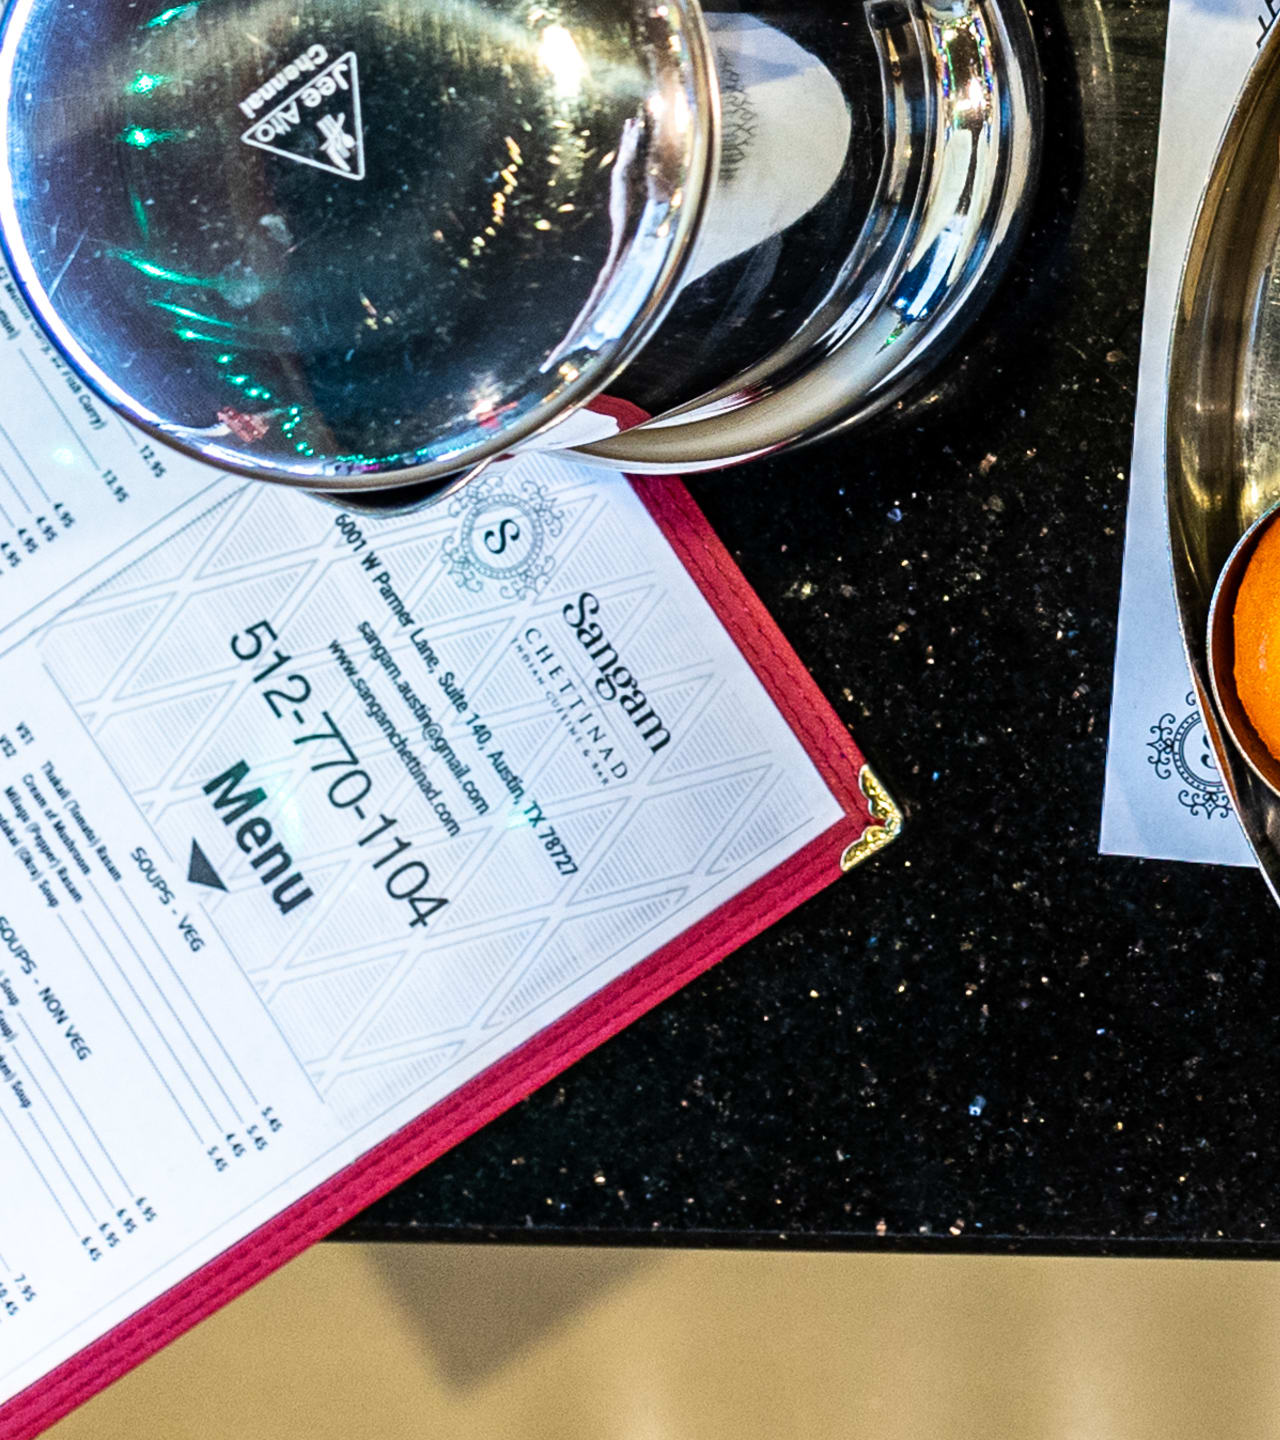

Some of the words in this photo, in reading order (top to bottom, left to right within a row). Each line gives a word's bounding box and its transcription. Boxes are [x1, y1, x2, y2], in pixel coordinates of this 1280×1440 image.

[301, 63, 349, 108] Jee
[140, 445, 166, 477] 12.95
[37, 517, 57, 542] 4.95
[54, 503, 74, 528] 4.95
[18, 529, 38, 553] 4.95
[563, 592, 671, 754] Sangam
[335, 512, 367, 552] 6001
[361, 551, 381, 571] W
[372, 571, 415, 627] Parmer
[410, 628, 439, 673] Lane,
[438, 672, 468, 713] Suite
[466, 713, 492, 750] 140,
[487, 751, 524, 804] Austin,
[524, 800, 547, 828] TX
[539, 826, 578, 875] 78727
[526, 628, 627, 779] CHETTINAD
[328, 640, 460, 837] www.sangamchettinad.com
[358, 621, 489, 816] sangam.austin@gmail.com
[231, 620, 449, 927] 512-770-1104
[23, 774, 46, 808] Cream
[45, 809, 58, 820] of
[53, 820, 90, 875] Mushroom
[203, 760, 313, 915] Menu
[27, 823, 60, 868] (Pepper)
[57, 867, 82, 902] Rasam
[96, 846, 121, 881] Rasam
[39, 880, 58, 907] Soup
[131, 847, 174, 905] SOUPS
[178, 916, 204, 952] VEG
[0, 979, 19, 1006] Soup
[40, 987, 68, 1024] NON
[65, 1025, 91, 1060] VEG
[12, 1081, 31, 1108] Soup
[247, 1125, 267, 1150] 5.45
[262, 1107, 282, 1132] 5.45
[207, 1146, 227, 1172] 5.45
[15, 1274, 36, 1302] 7.95
